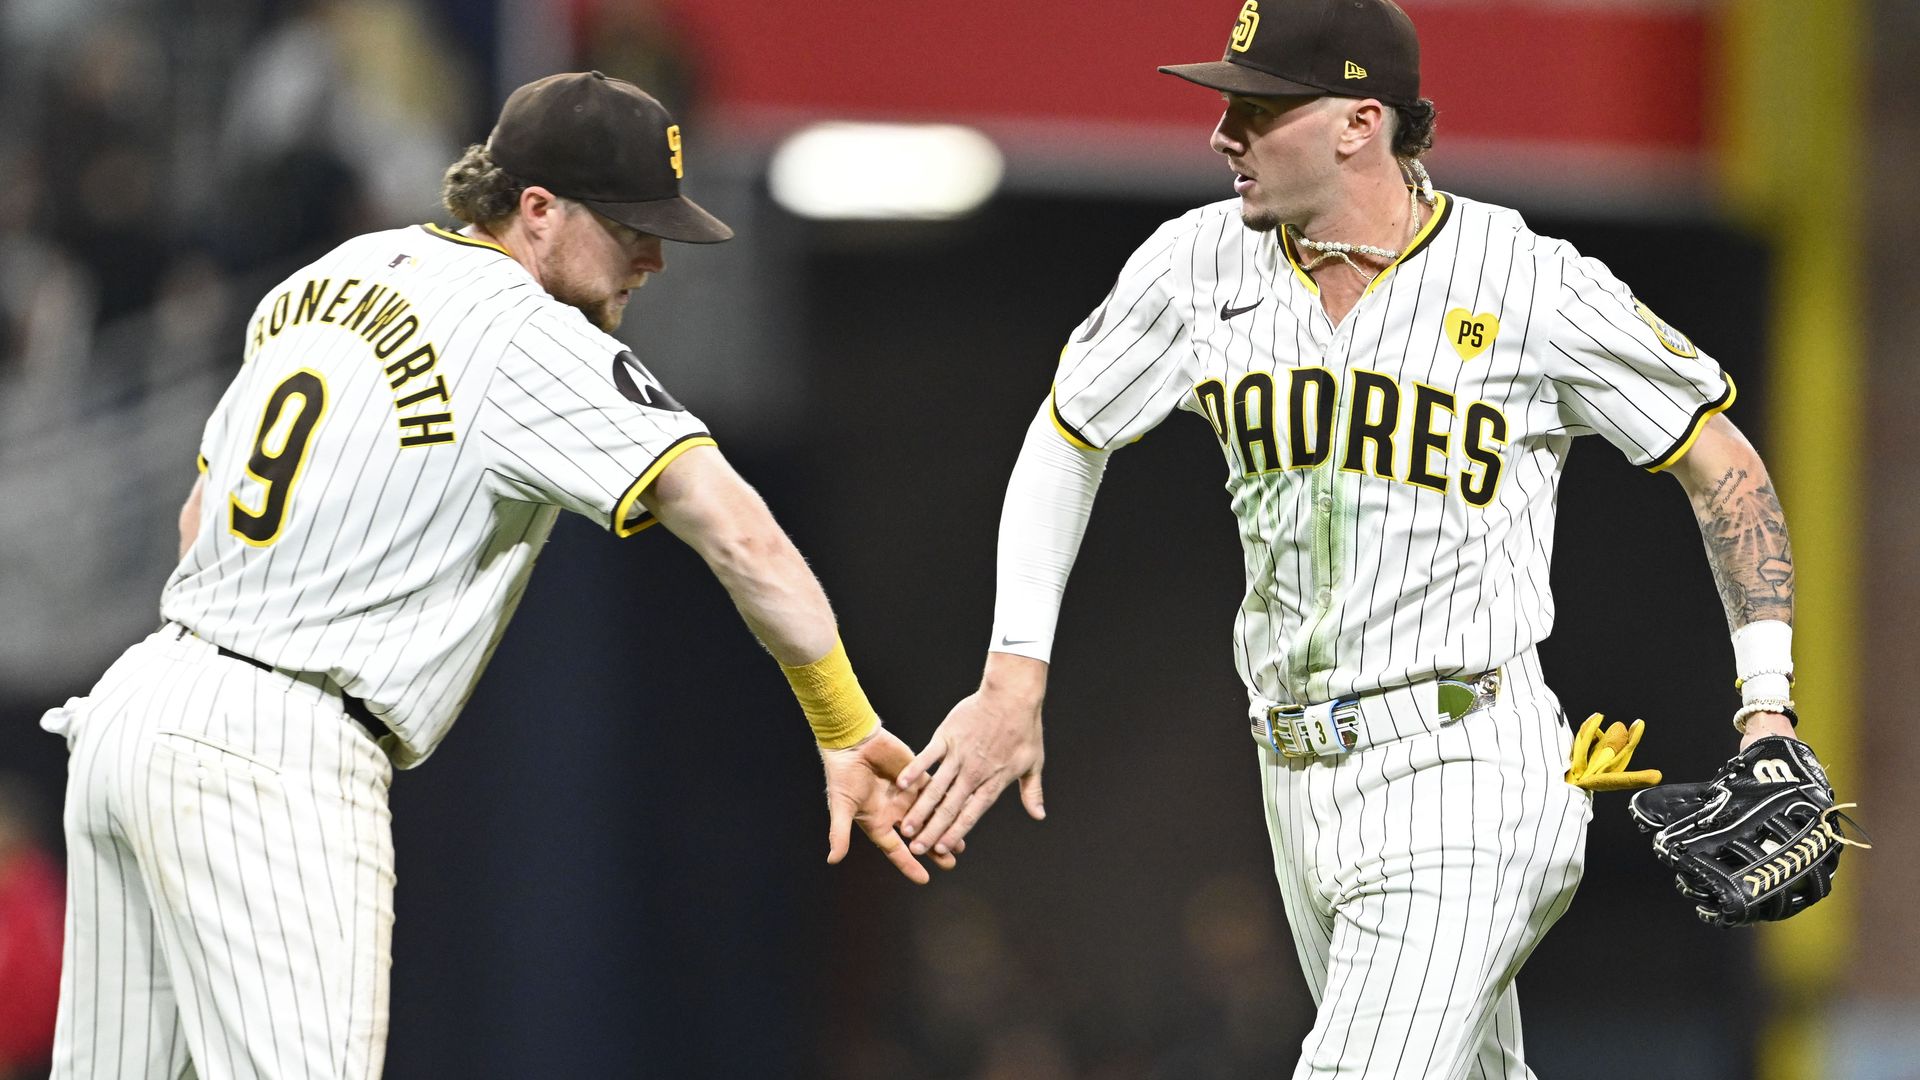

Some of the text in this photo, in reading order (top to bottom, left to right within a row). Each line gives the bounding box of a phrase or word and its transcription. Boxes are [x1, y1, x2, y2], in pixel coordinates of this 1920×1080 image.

[250, 277, 456, 449] RONENWORTH
[1457, 320, 1485, 348] PS
[229, 367, 328, 547] 9
[1193, 366, 1508, 508] PADRES
[1314, 720, 1327, 745] 3
